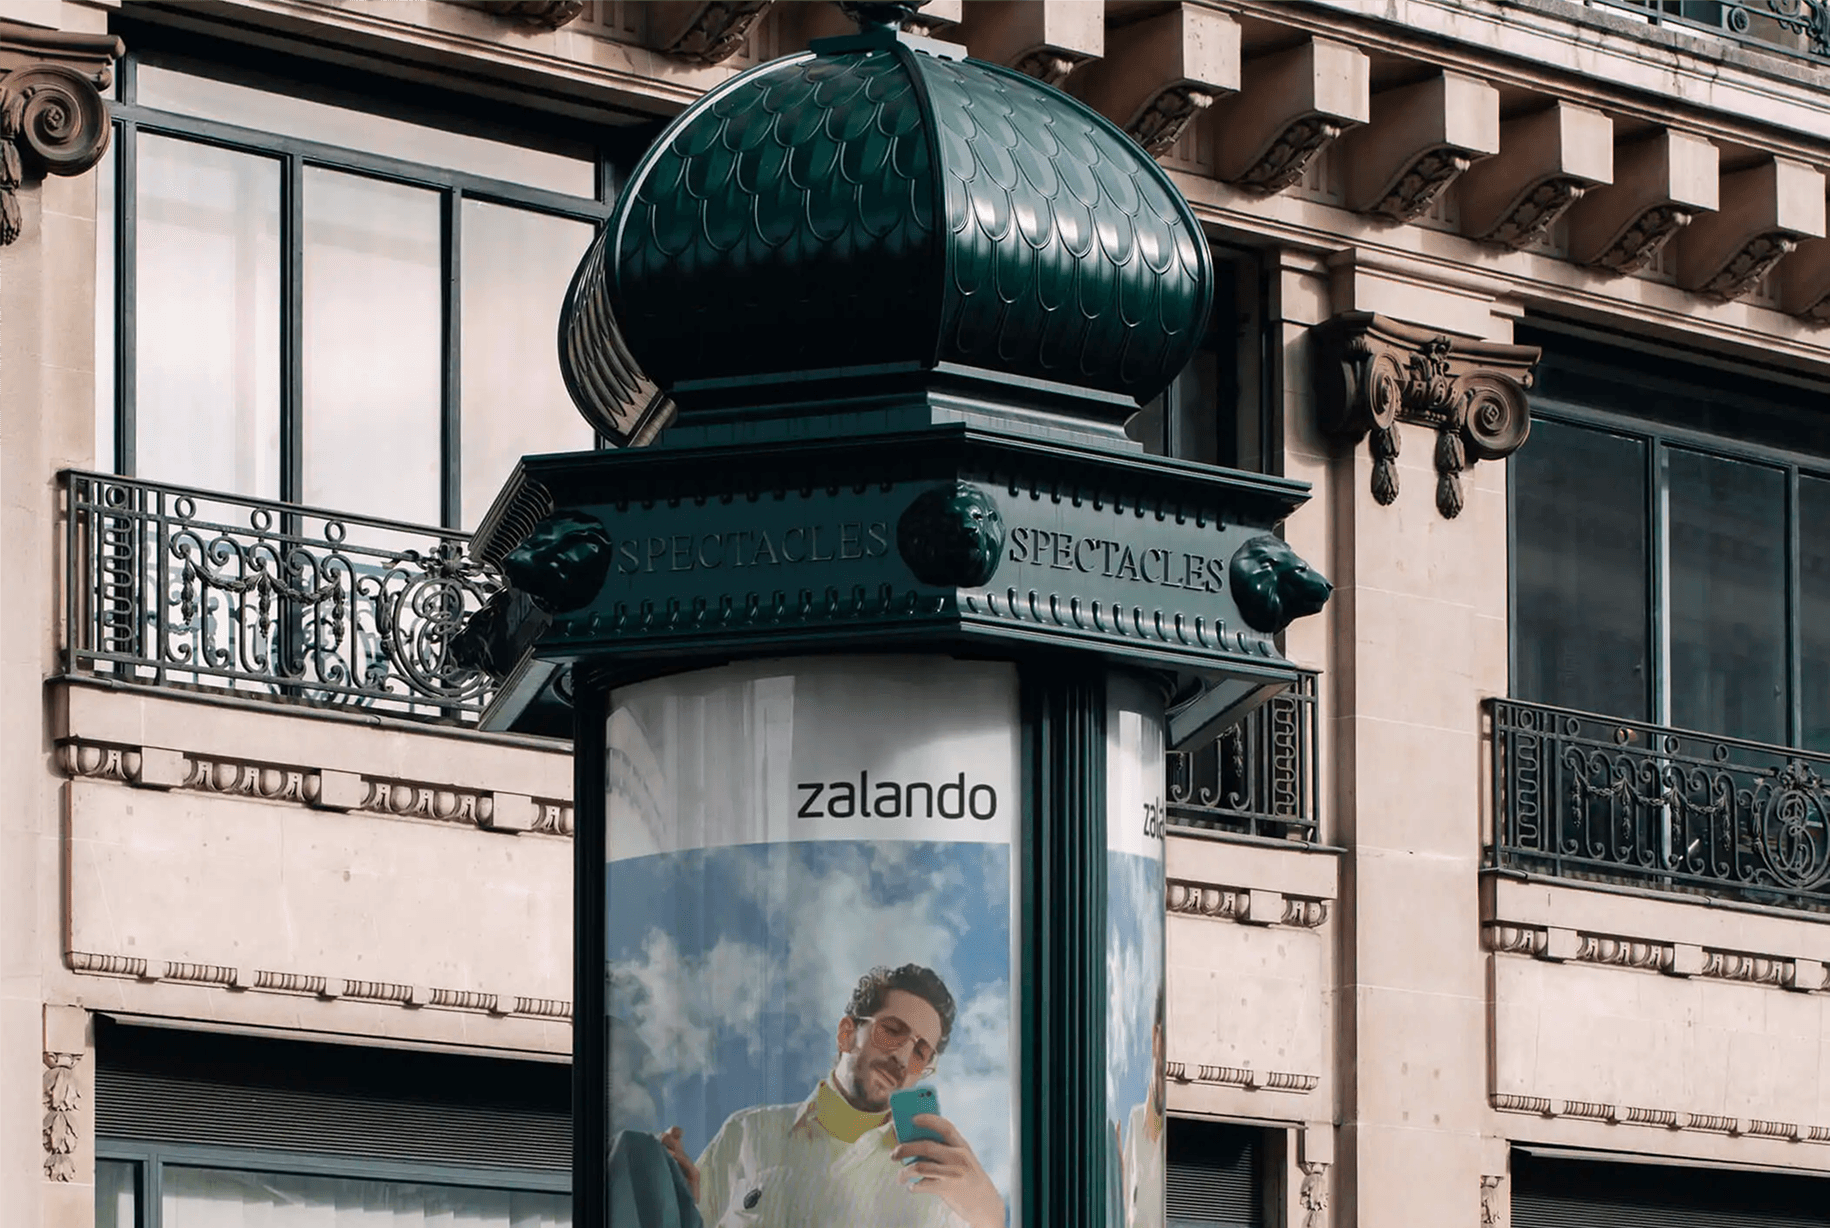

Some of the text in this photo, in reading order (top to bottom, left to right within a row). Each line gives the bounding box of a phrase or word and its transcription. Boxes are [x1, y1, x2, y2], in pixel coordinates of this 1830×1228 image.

[617, 521, 889, 573] SPECTACLES
[1009, 525, 1225, 593] SPECTACLES
[797, 770, 997, 820] zalando
